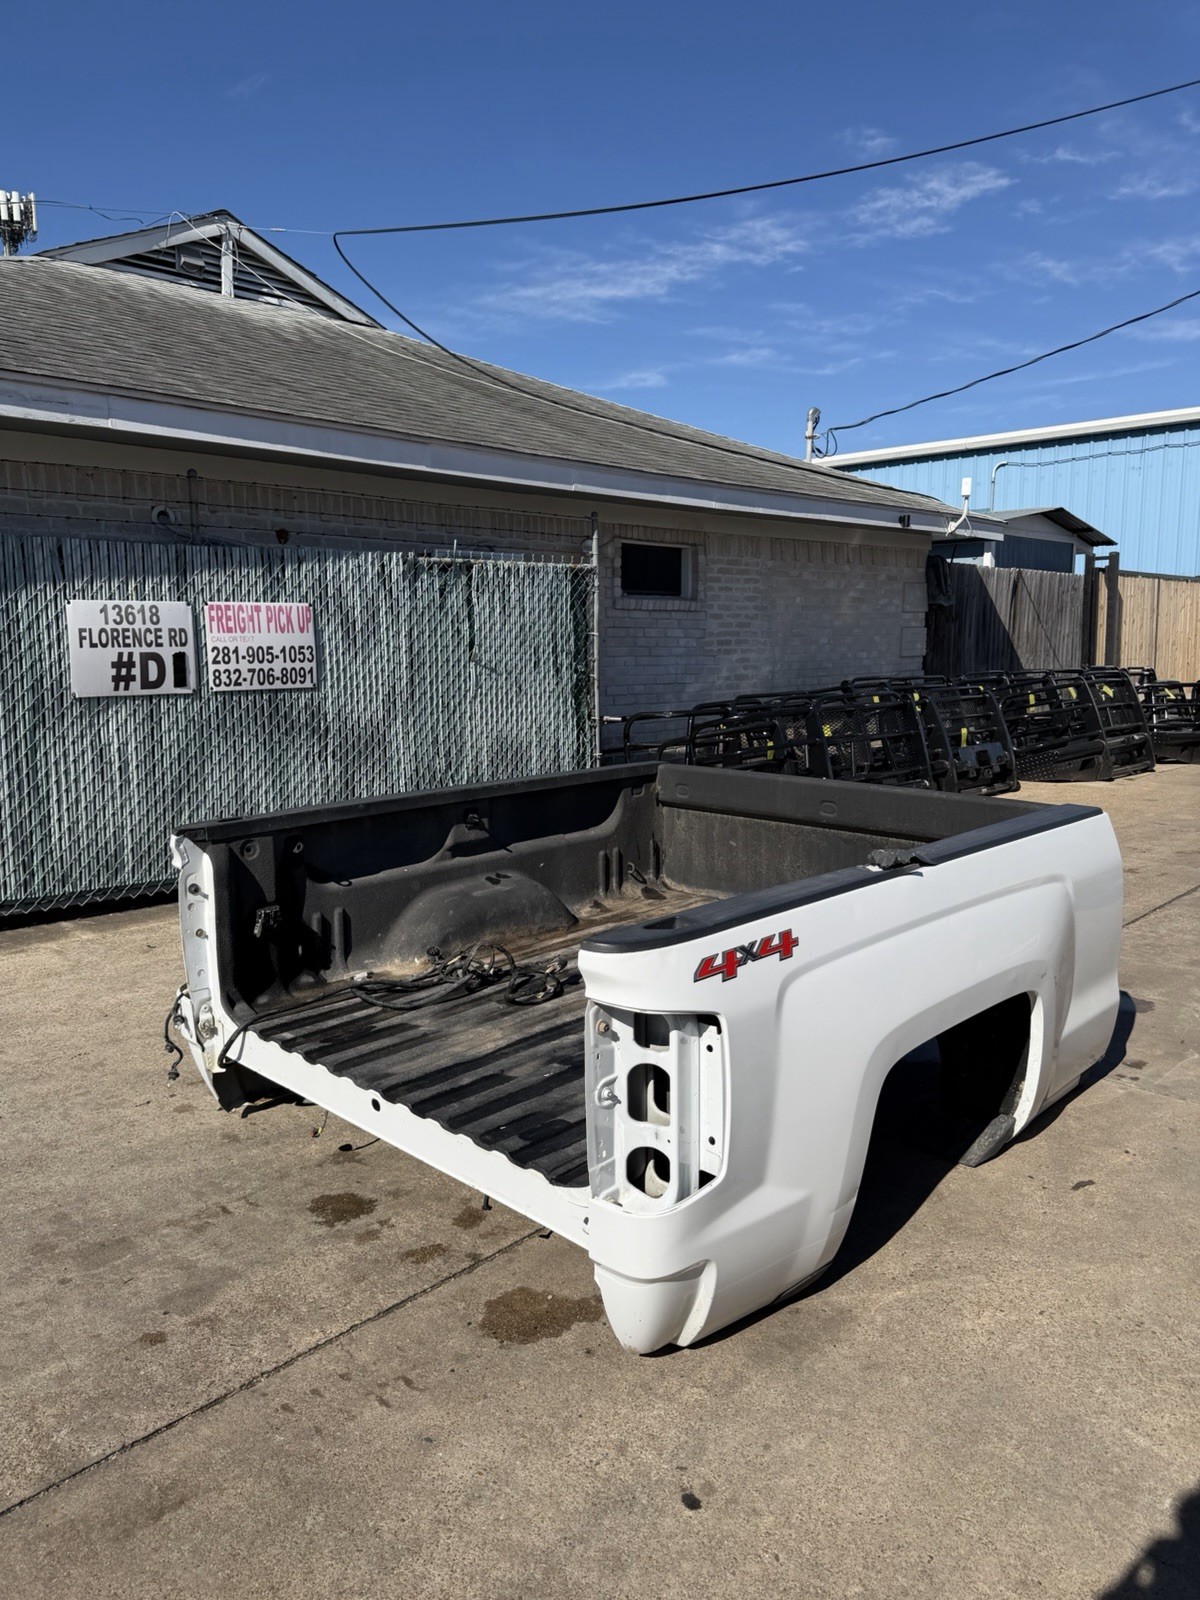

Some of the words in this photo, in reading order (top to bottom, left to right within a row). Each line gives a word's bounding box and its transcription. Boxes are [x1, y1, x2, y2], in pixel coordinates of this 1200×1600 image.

[99, 604, 161, 626] 13618
[208, 604, 262, 634] FREIGHT
[265, 605, 295, 634] PICK
[296, 605, 312, 634] UP
[78, 627, 164, 649] FLORENCE
[168, 627, 188, 648] RD
[211, 635, 227, 643] CALL
[228, 635, 239, 643] OR
[240, 635, 255, 643] TEXT
[211, 645, 315, 665] 281-905-1053
[212, 666, 314, 688] 832-706-8091
